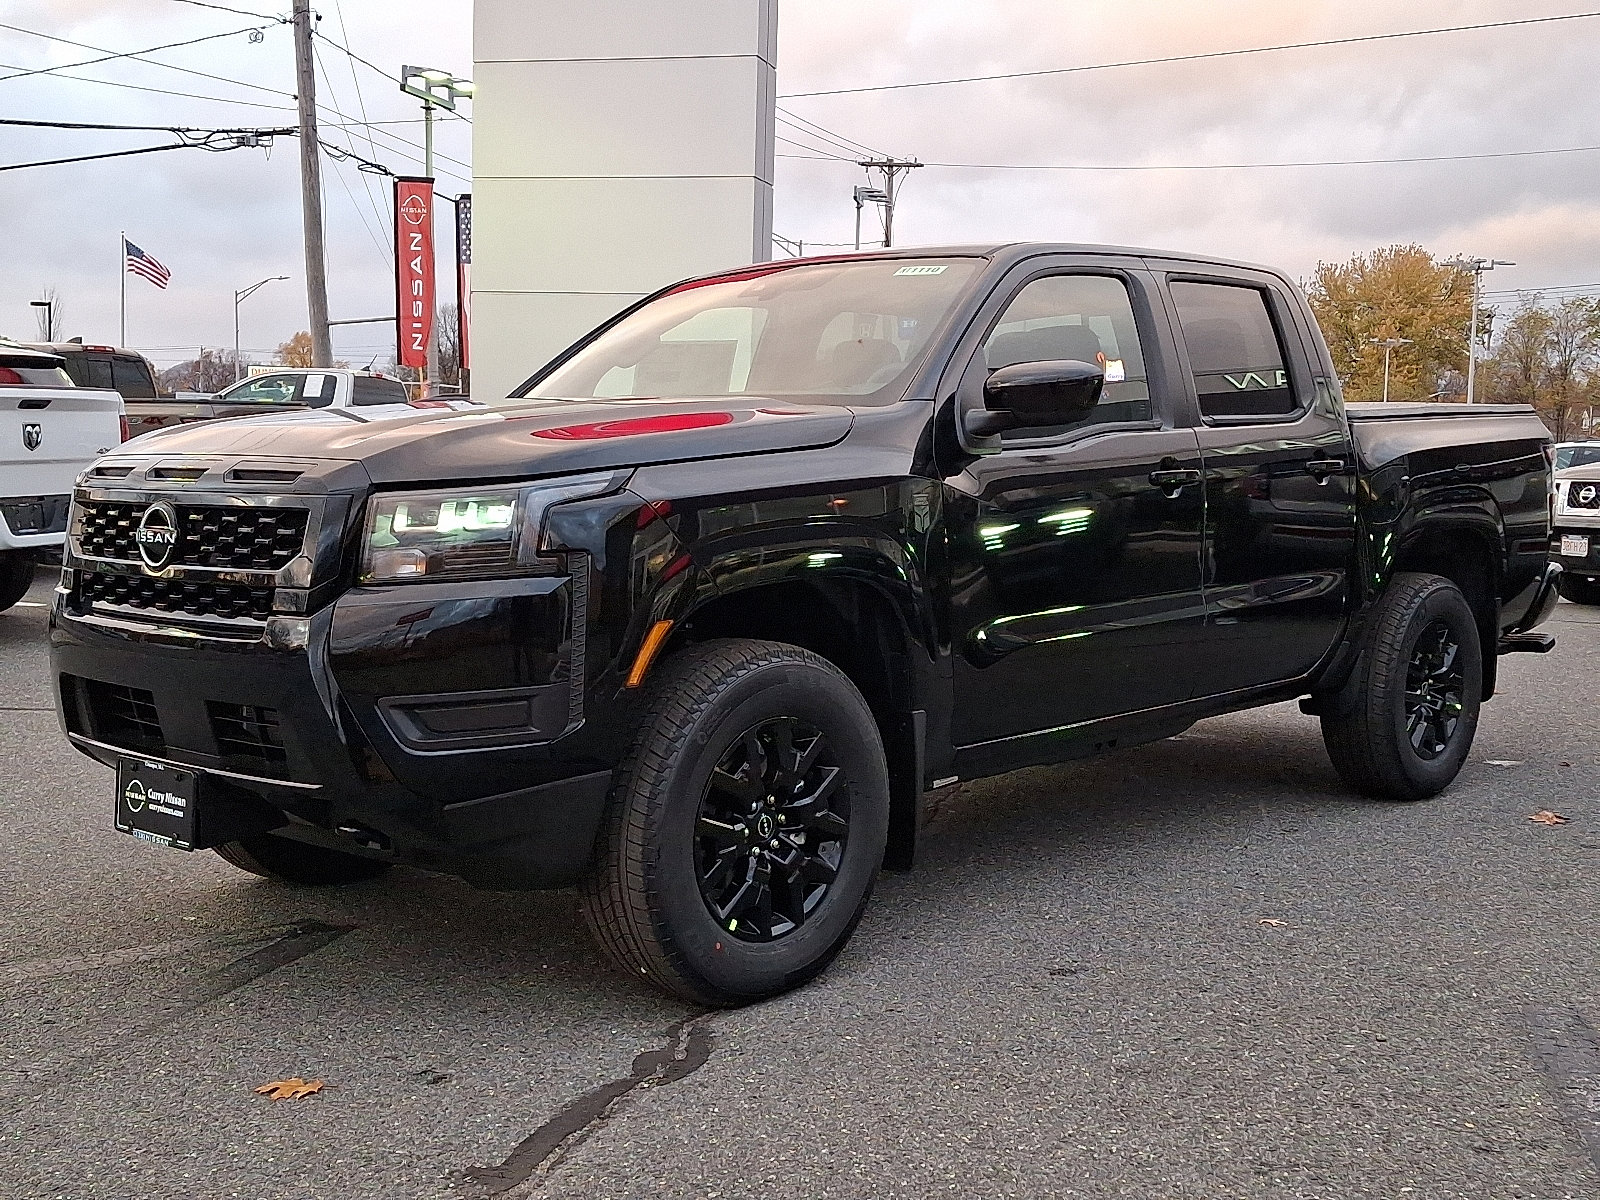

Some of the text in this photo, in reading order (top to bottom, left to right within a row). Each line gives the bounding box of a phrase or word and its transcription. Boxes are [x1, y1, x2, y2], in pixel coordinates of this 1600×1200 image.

[409, 232, 424, 351] NISSAN
[147, 788, 186, 807] Curry Nissan
